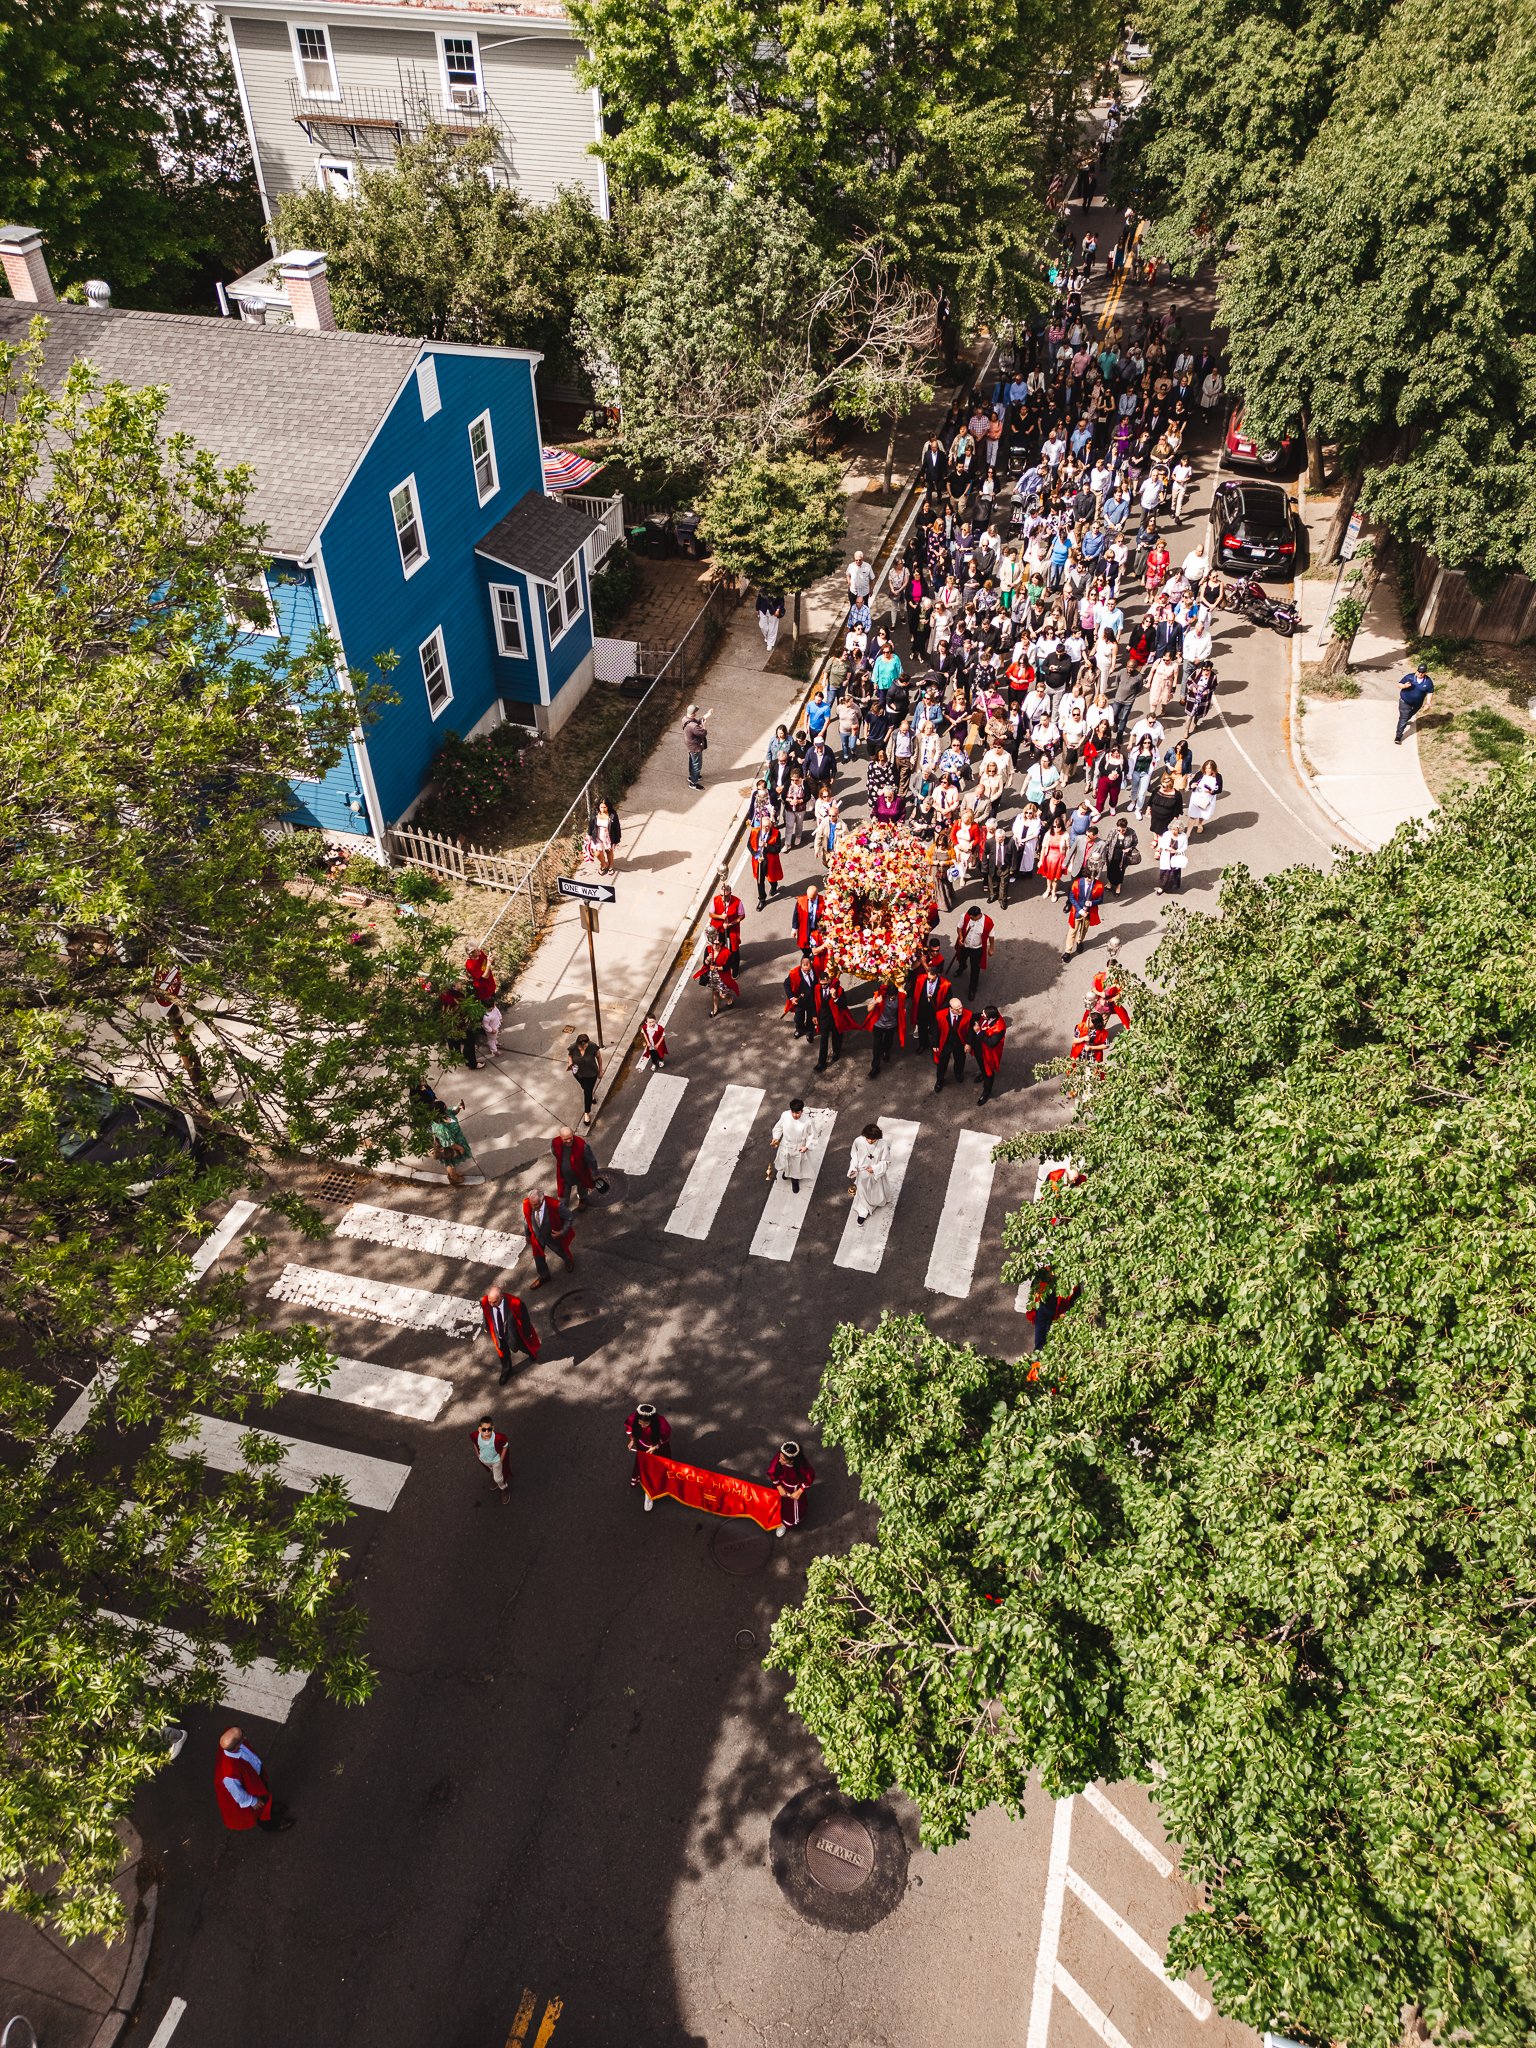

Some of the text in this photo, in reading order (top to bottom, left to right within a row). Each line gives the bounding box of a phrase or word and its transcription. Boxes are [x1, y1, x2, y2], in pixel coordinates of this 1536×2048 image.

[564, 883, 598, 896] ONE WAY
[666, 1470, 704, 1484] ECCE
[818, 1839, 863, 1865] SEWER
